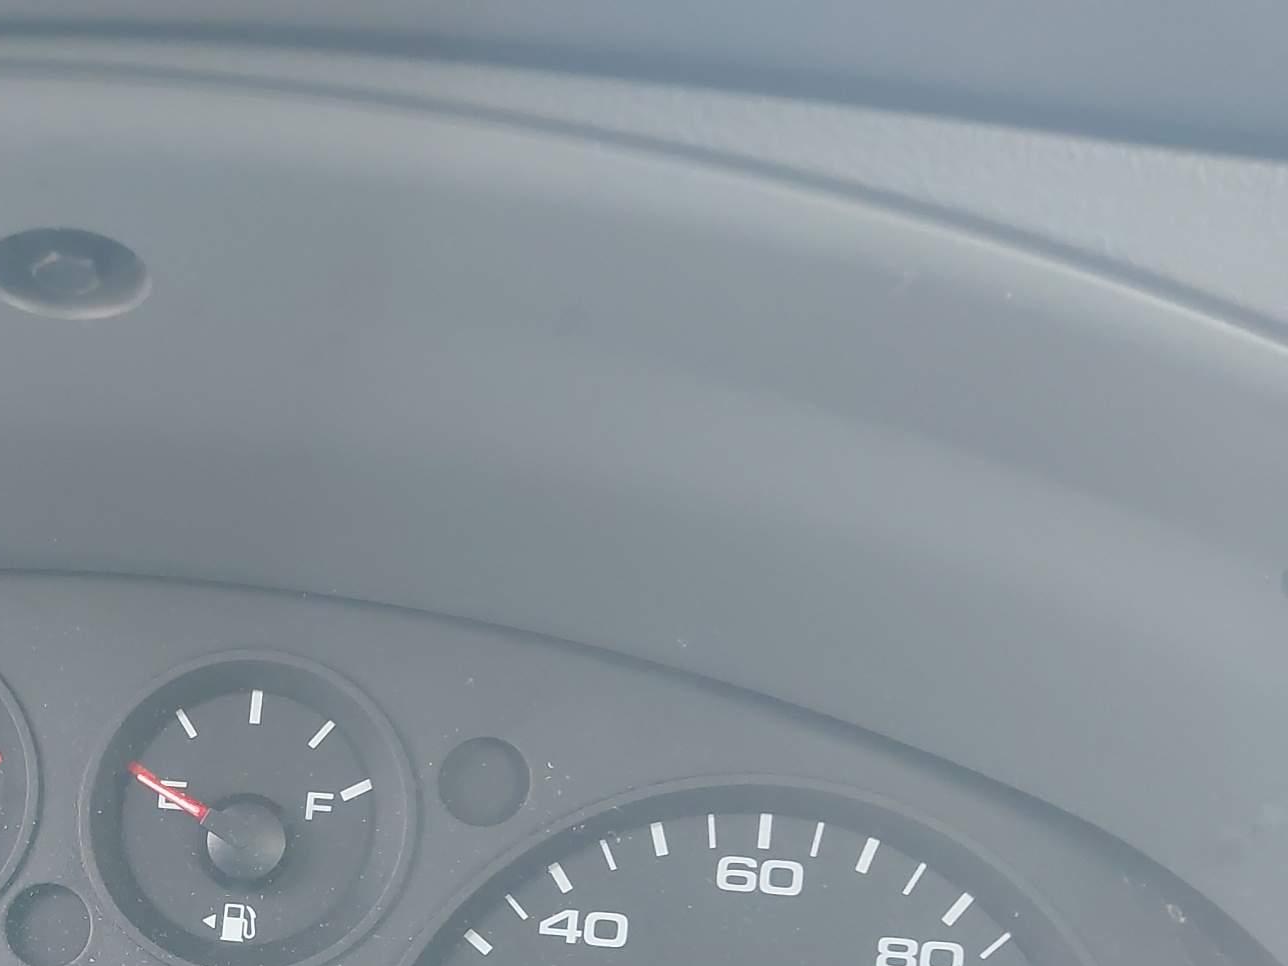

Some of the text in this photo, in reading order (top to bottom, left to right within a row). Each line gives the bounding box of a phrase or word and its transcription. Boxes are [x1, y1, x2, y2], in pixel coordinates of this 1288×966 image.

[305, 792, 334, 820] F
[716, 856, 804, 896] 60
[539, 909, 629, 948] 40
